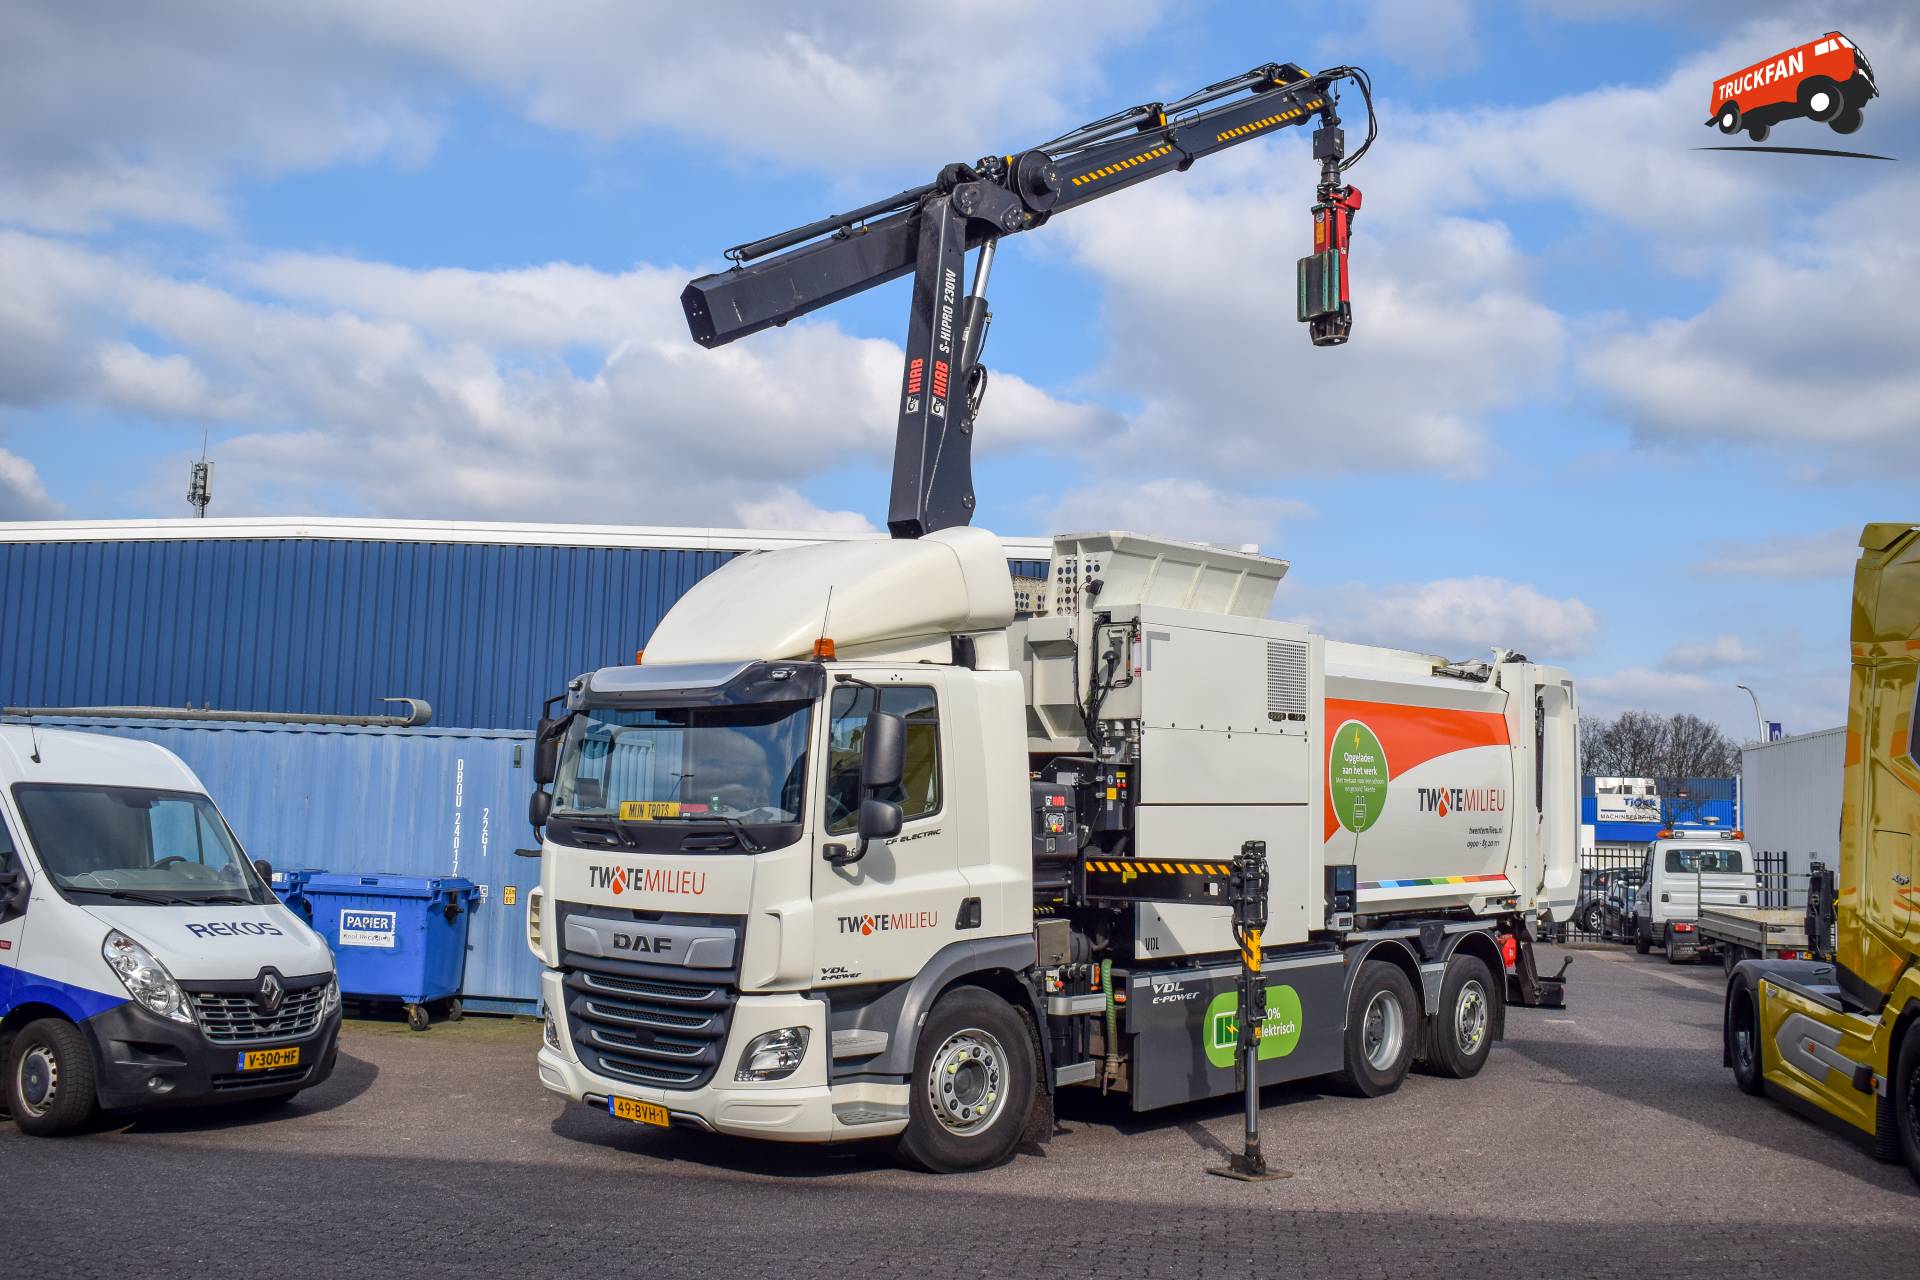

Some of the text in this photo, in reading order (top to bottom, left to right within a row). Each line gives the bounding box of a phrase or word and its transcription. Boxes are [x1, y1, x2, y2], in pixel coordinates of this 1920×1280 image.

[939, 268, 957, 354] S-HIPRO 230W
[908, 357, 924, 394] HIAB
[932, 360, 949, 399] HIAB
[1343, 752, 1375, 764] Opgeladen
[1353, 766, 1364, 775] het
[1364, 766, 1378, 775] werk
[455, 758, 464, 808] DBOU
[481, 807, 489, 857] 22G1
[899, 828, 942, 843] ELECTRIC
[184, 922, 284, 938] REKOS
[346, 915, 389, 930] PAPIER
[613, 931, 672, 953] DAF
[1144, 936, 1160, 951] VDL
[820, 966, 849, 974] VDL
[1152, 982, 1185, 994] VDL
[1261, 1020, 1295, 1038] lektrisch
[248, 1049, 298, 1067] V-300-HF
[617, 1100, 664, 1124] 49-BVH-1
